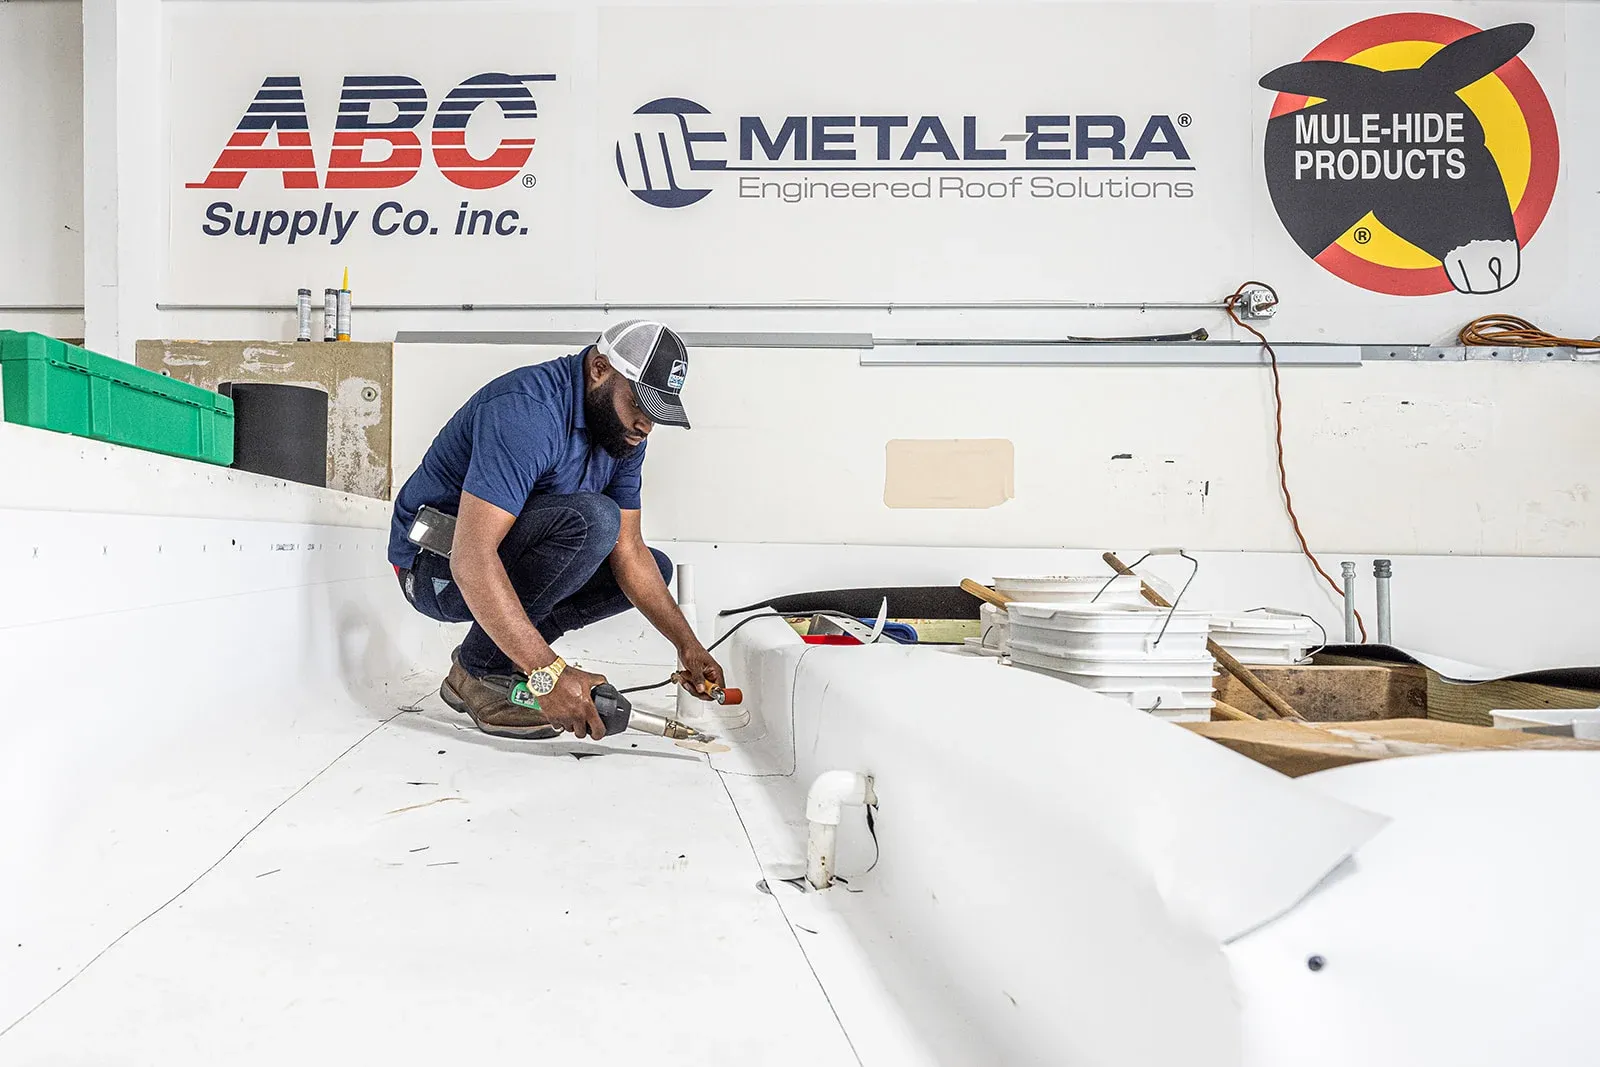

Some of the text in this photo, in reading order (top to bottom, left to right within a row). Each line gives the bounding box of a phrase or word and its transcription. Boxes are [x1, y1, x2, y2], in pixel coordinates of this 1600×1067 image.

[185, 73, 556, 190] ABC
[739, 115, 1191, 161] METAL-ERA
[1294, 112, 1465, 146] MULE-HIDE
[1294, 148, 1466, 182] PRODUCTS
[738, 176, 1194, 204] Engineered Roof Solutions
[202, 201, 529, 246] Supply Co. inc.
